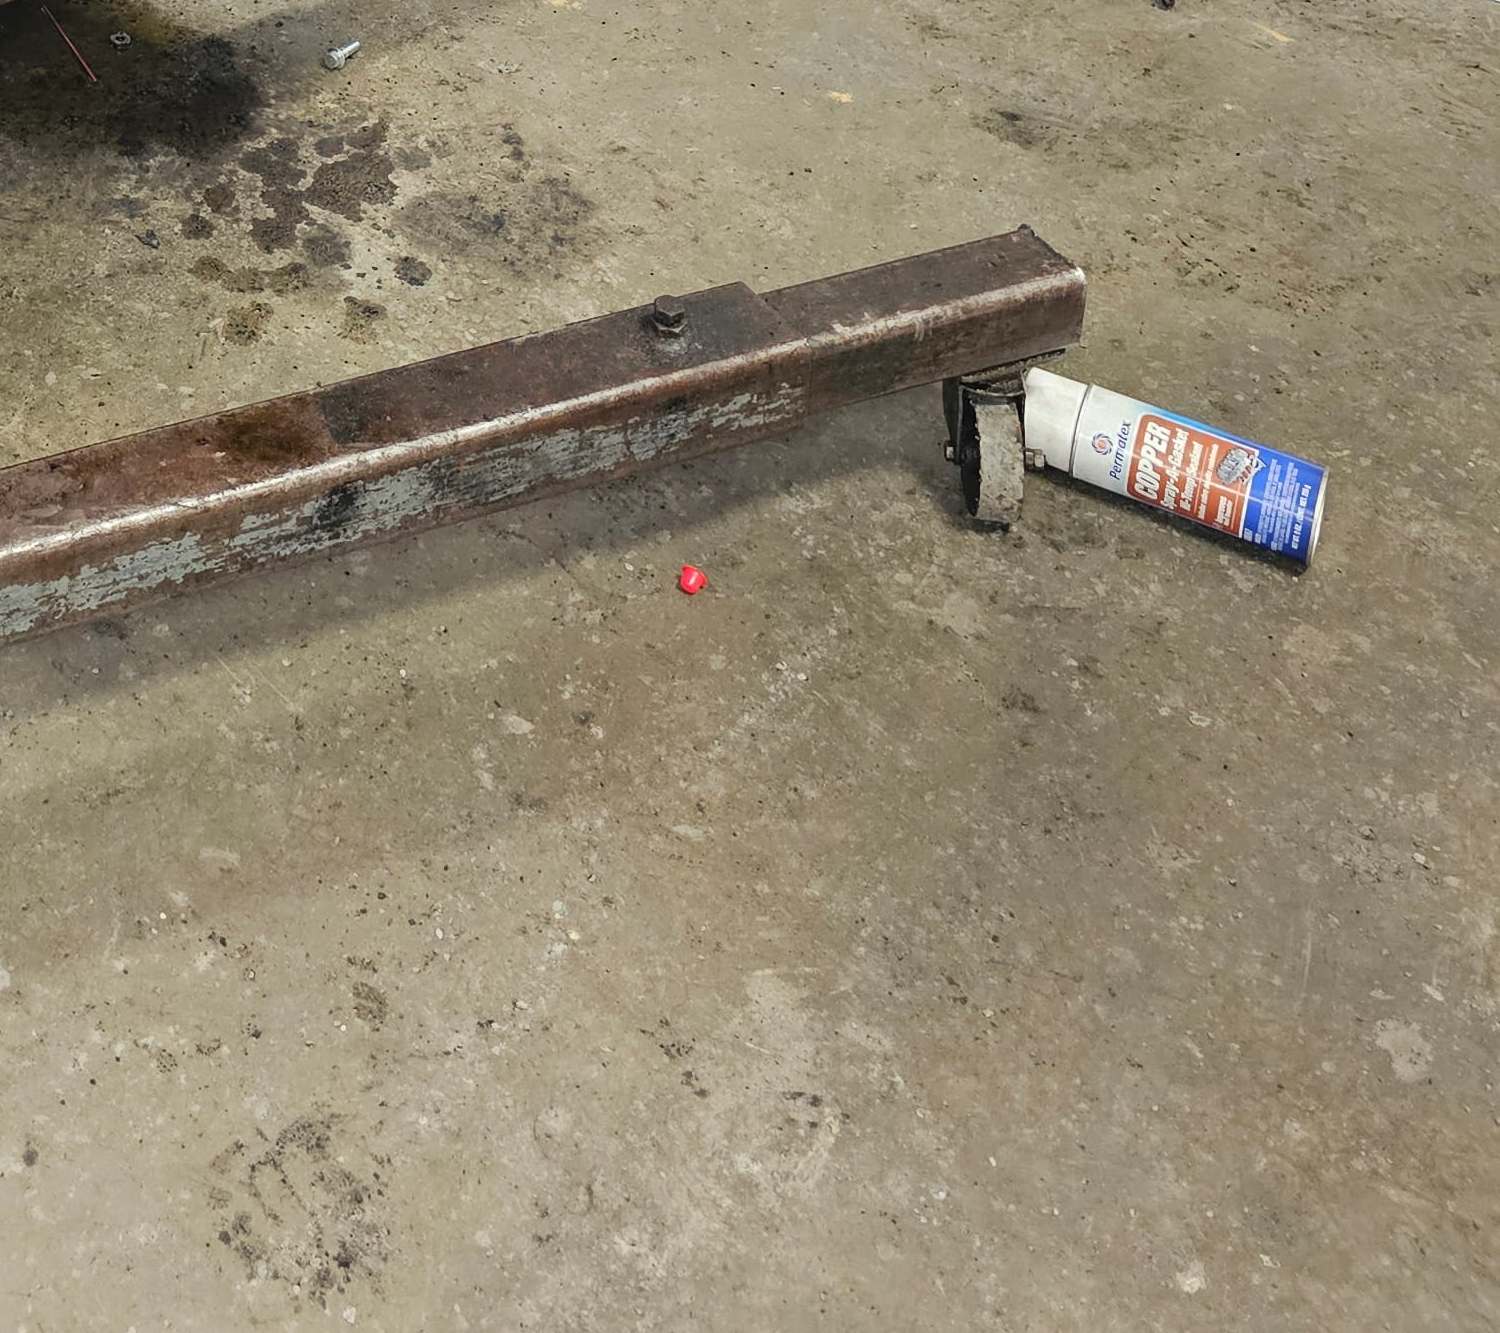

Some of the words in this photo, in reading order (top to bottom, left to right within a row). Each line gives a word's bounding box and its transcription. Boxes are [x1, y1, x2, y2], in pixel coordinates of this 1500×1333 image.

[1109, 420, 1131, 480] Permatex
[1134, 421, 1171, 500] COPPER
[1160, 427, 1189, 510] Spray-A-Gasket
